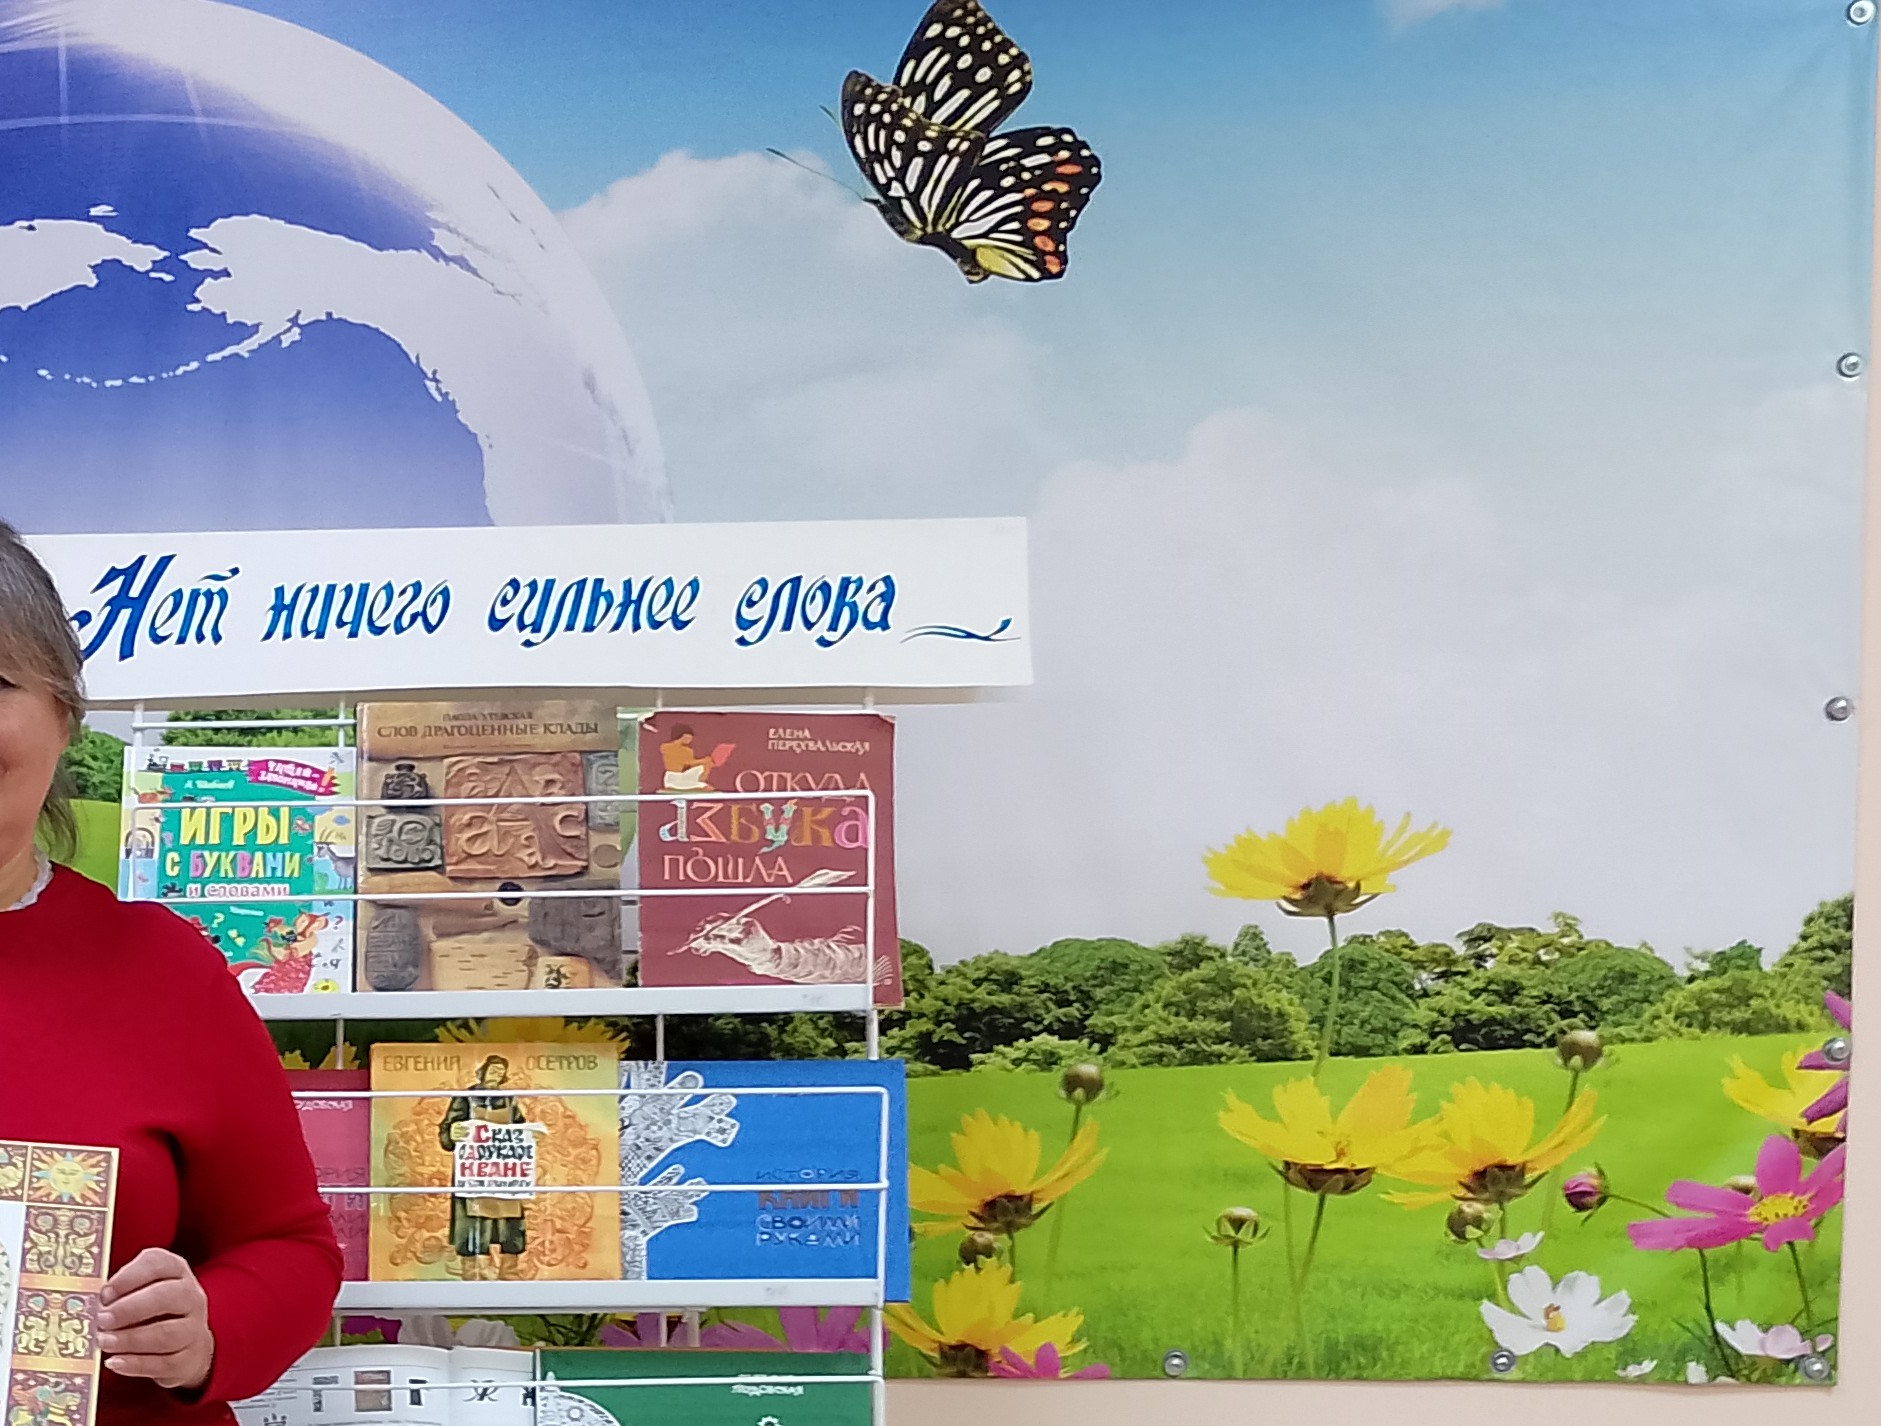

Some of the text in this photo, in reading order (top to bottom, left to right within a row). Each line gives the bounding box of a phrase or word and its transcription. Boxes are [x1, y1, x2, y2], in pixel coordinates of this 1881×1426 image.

[71, 553, 897, 662] Нет ничего сильнее слова
[377, 722, 600, 738] СЛОВ ДРАГОЦЕННЫЕ КЛАДЫ
[768, 728, 811, 739] ЕЛЕНА
[735, 770, 871, 799] ОТКУДА
[180, 806, 290, 845] ИГРЫ
[189, 850, 301, 878] БУКВАМИ
[663, 847, 793, 883] ПОШЛА
[205, 884, 290, 897] словами
[526, 1055, 599, 1071] ОСЕТРОВ
[756, 1168, 862, 1182] ИСТОРИЯ
[755, 1214, 860, 1230] СВОИМИ
[755, 1232, 860, 1247] РУКАМИ
